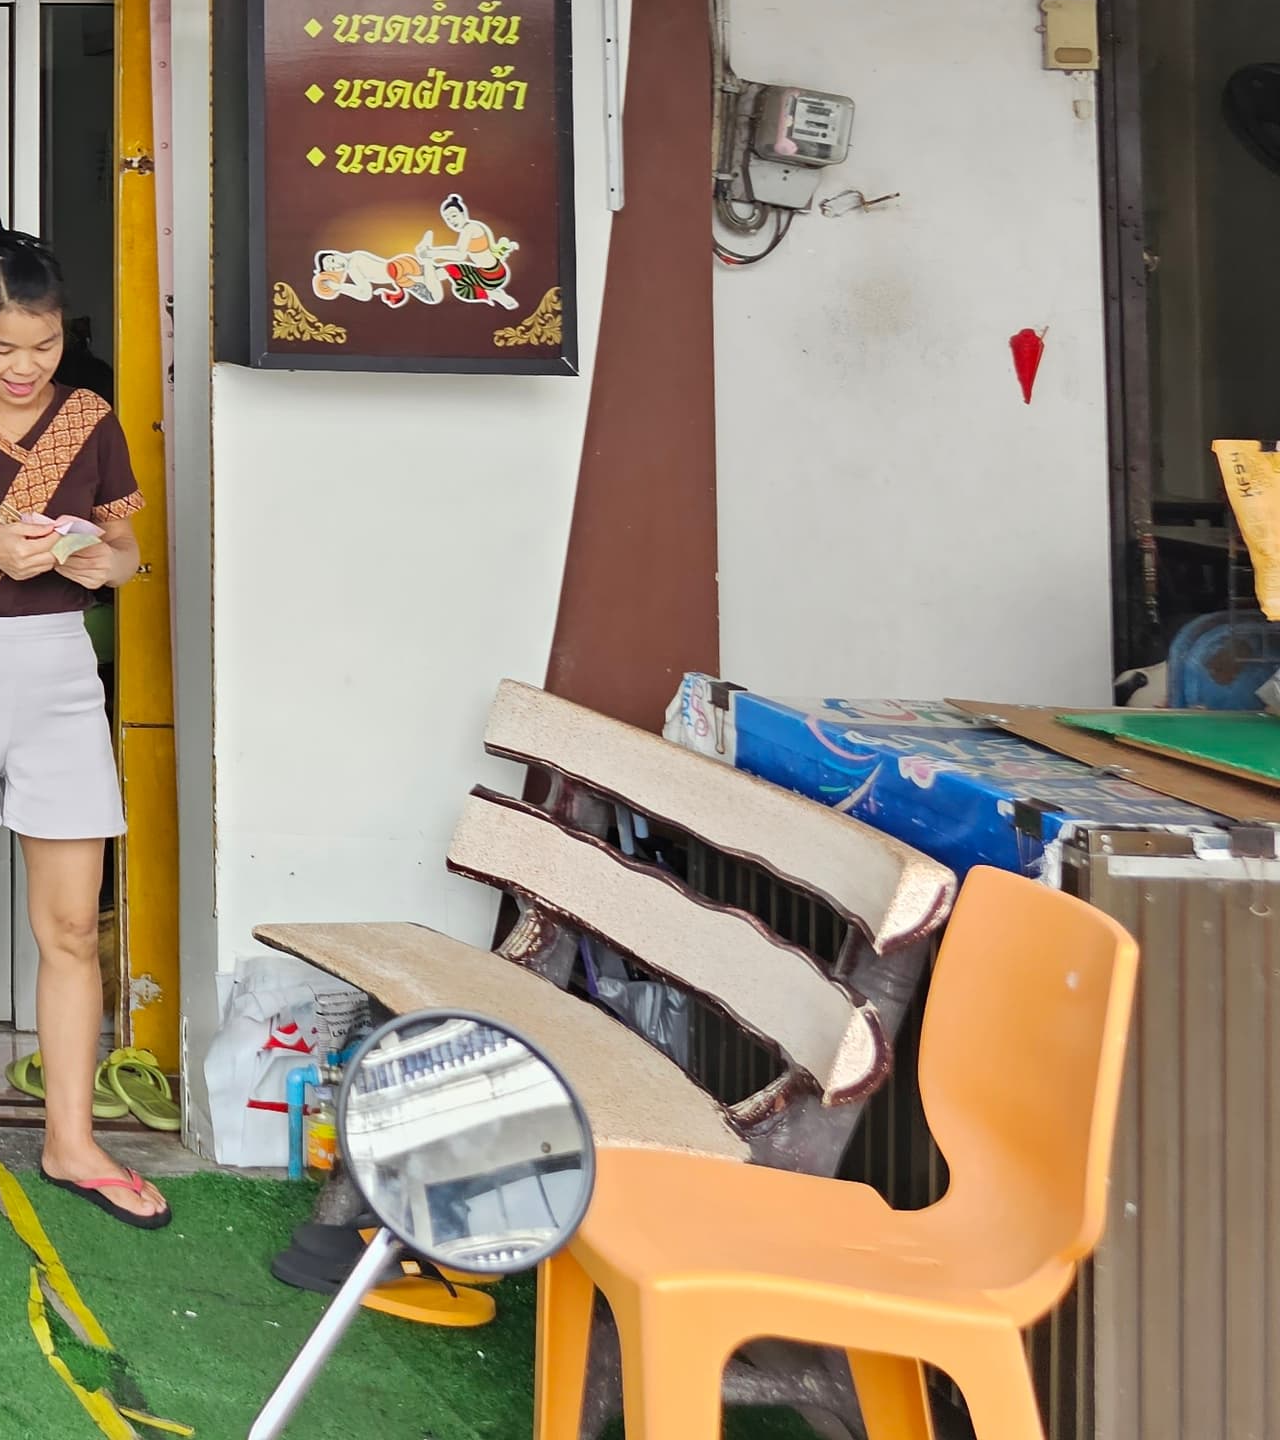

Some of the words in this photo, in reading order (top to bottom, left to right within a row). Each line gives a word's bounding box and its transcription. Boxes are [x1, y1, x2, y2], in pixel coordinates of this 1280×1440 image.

[333, 65, 528, 110] นวดฝ่าเท้า
[334, 130, 467, 175] นวดตัว
